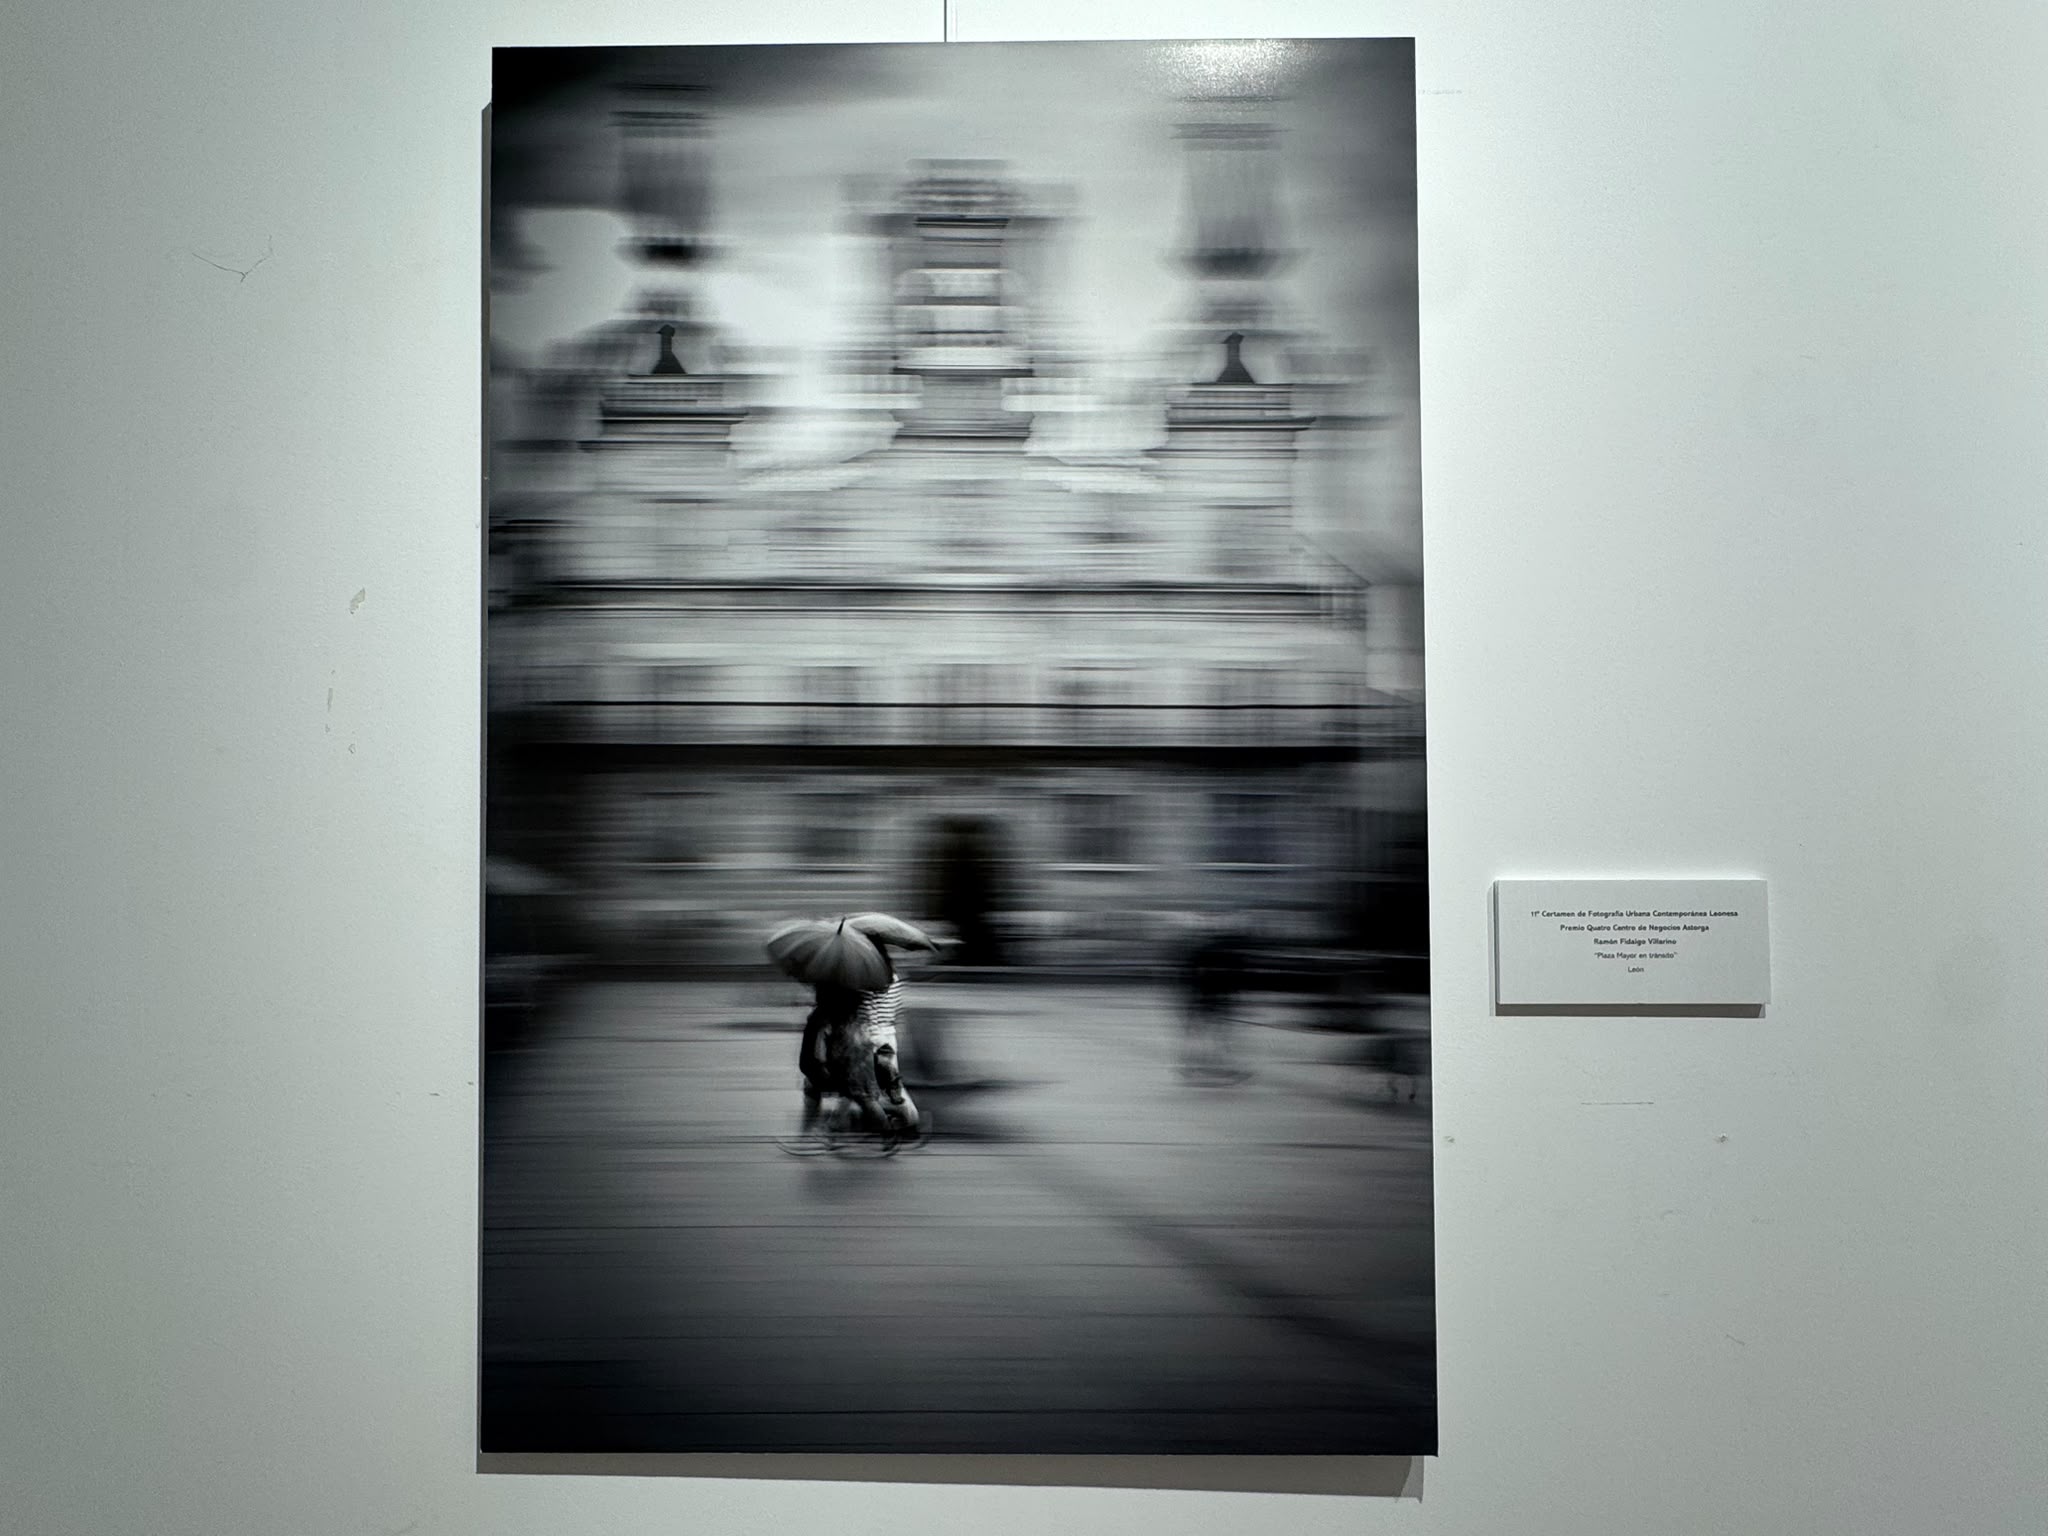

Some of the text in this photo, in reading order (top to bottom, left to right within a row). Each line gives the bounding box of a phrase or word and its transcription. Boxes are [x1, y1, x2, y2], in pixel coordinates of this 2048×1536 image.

[1541, 910, 1576, 918] Certamen
[1577, 910, 1586, 918] de
[1588, 910, 1624, 919] Fotografía
[1625, 910, 1651, 918] Urbana
[1652, 910, 1708, 919] Contemporánea
[1709, 910, 1739, 918] Leonesa
[1586, 924, 1611, 932] Quatro
[1649, 924, 1681, 933] Negocios
[1682, 924, 1710, 933] Astorga
[1620, 938, 1647, 947] Fidalgo
[1616, 952, 1638, 961] Mayor
